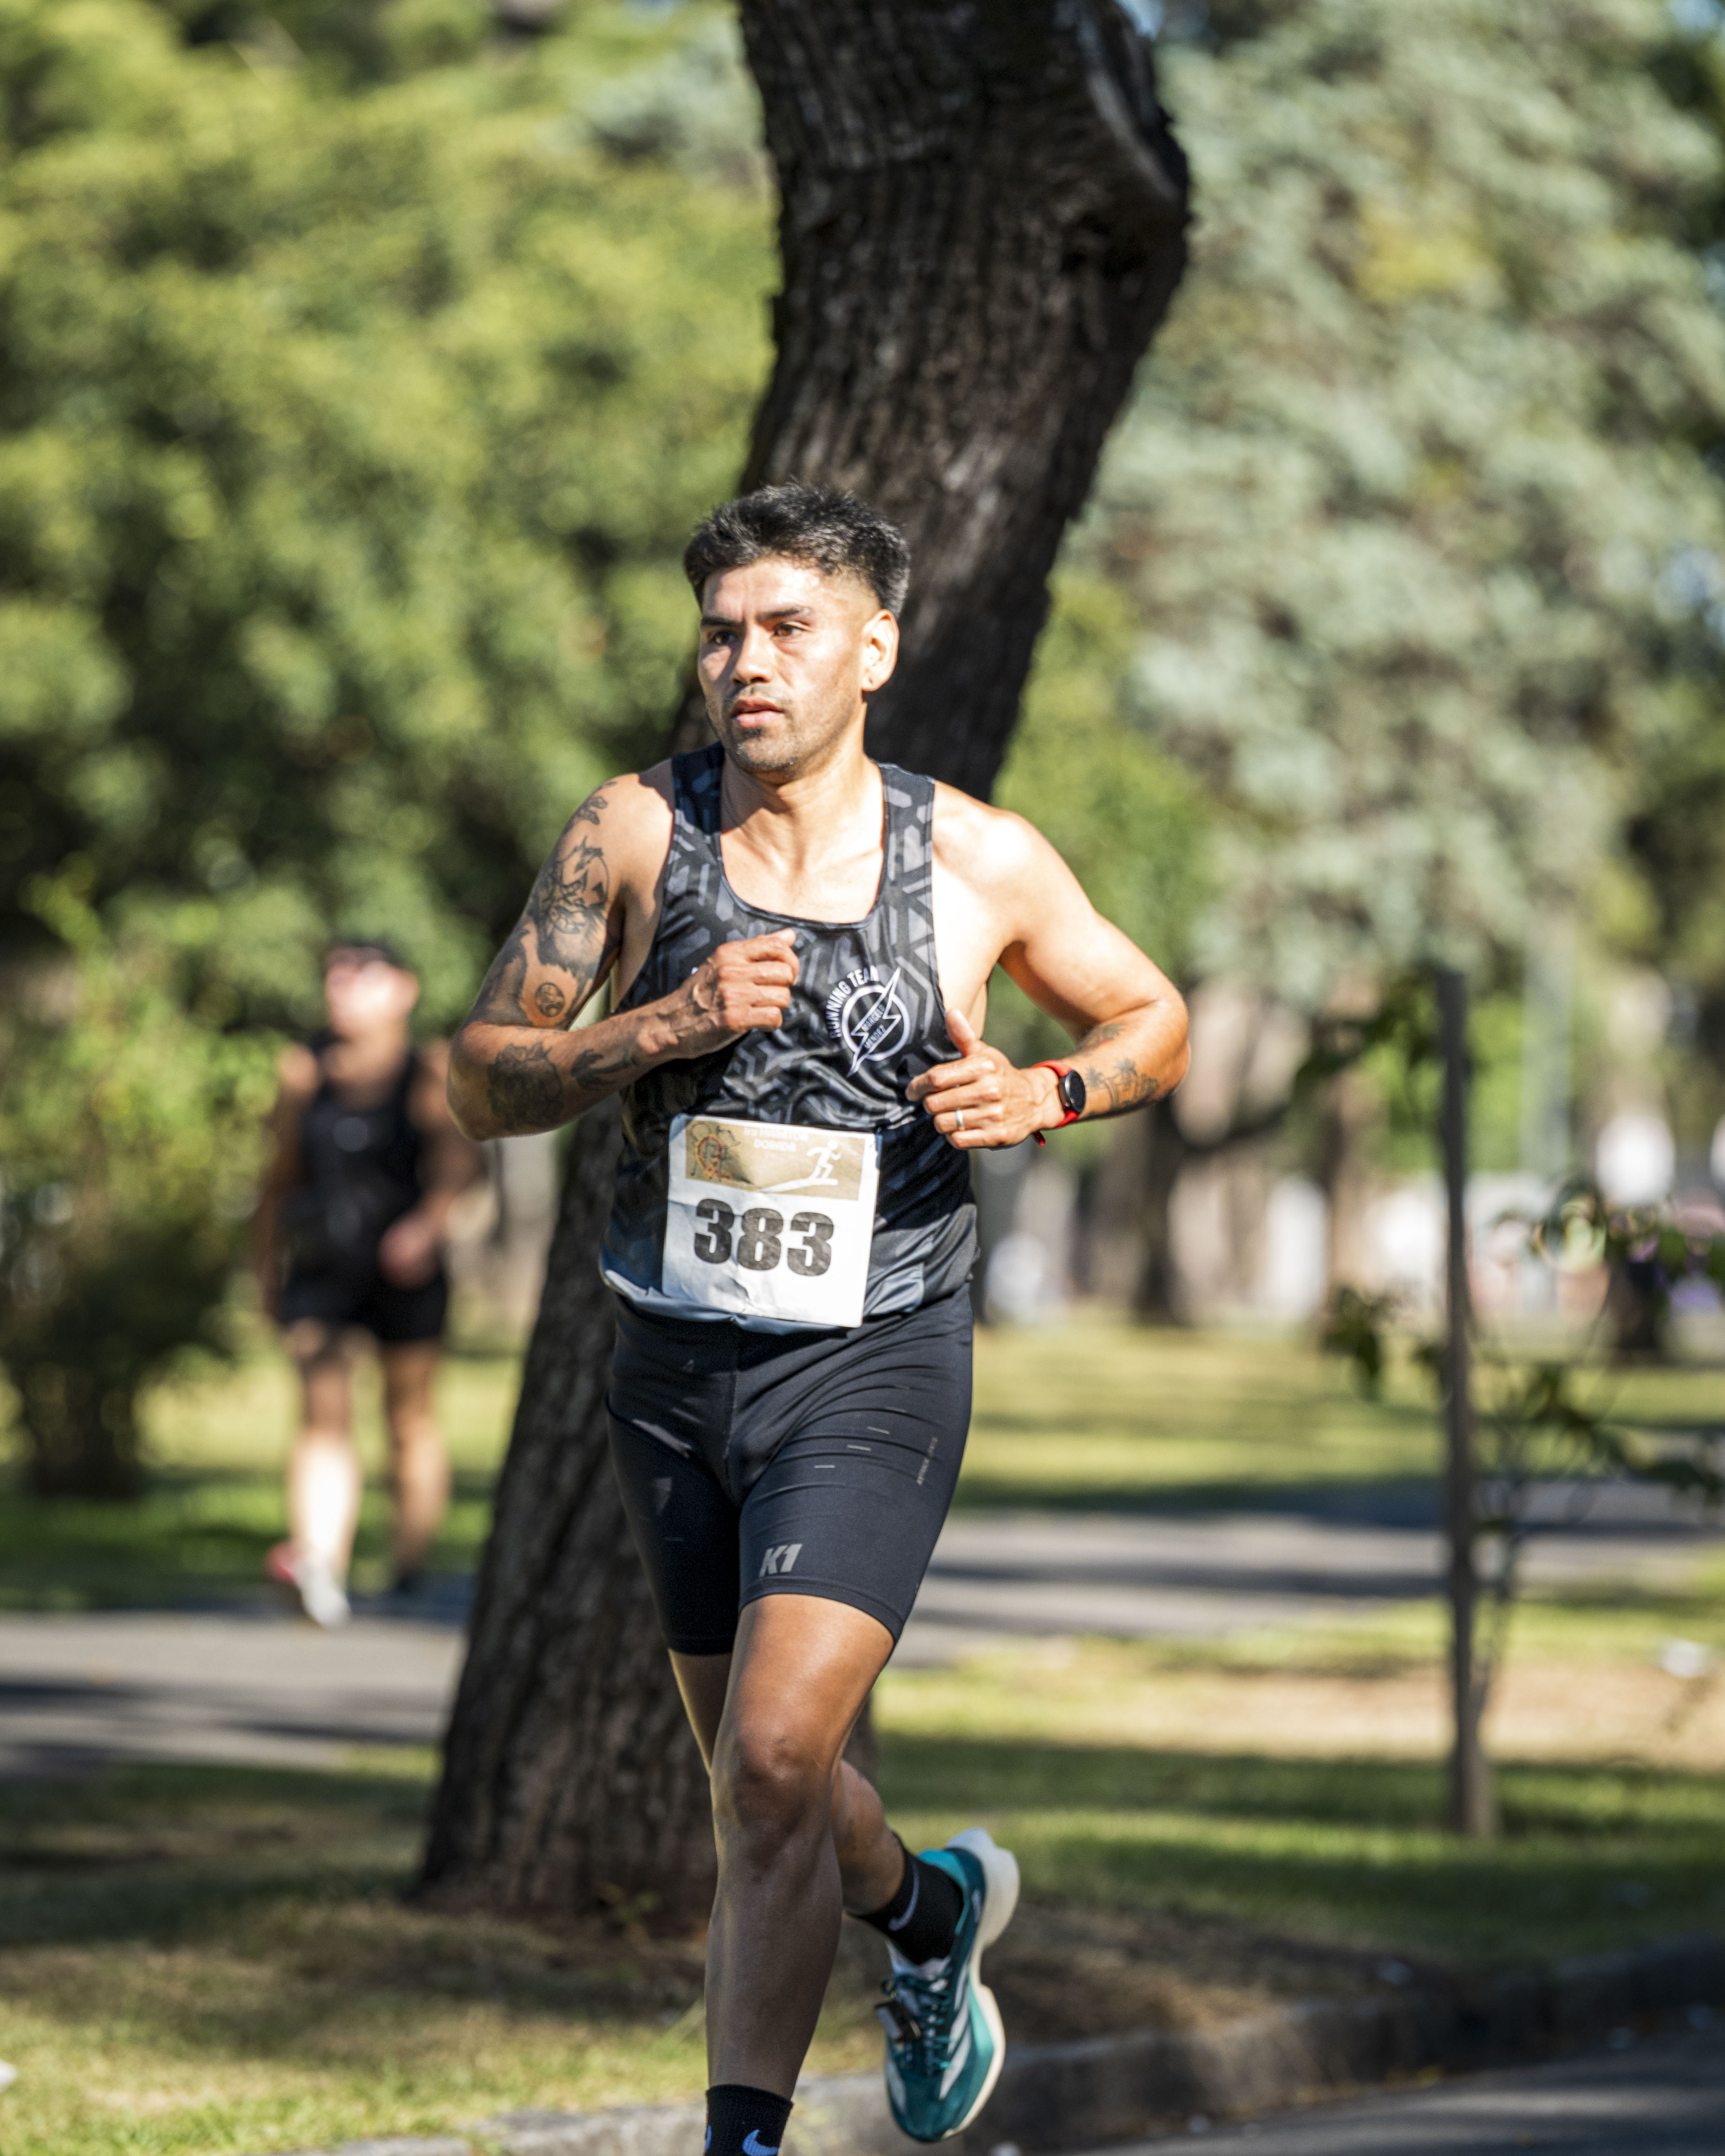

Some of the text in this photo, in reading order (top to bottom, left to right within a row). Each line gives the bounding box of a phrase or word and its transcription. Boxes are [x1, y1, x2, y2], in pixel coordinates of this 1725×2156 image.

[826, 964, 880, 1039] RUNNING TEAM
[694, 1199, 834, 1277] 383
[758, 1543, 803, 1577] K1
